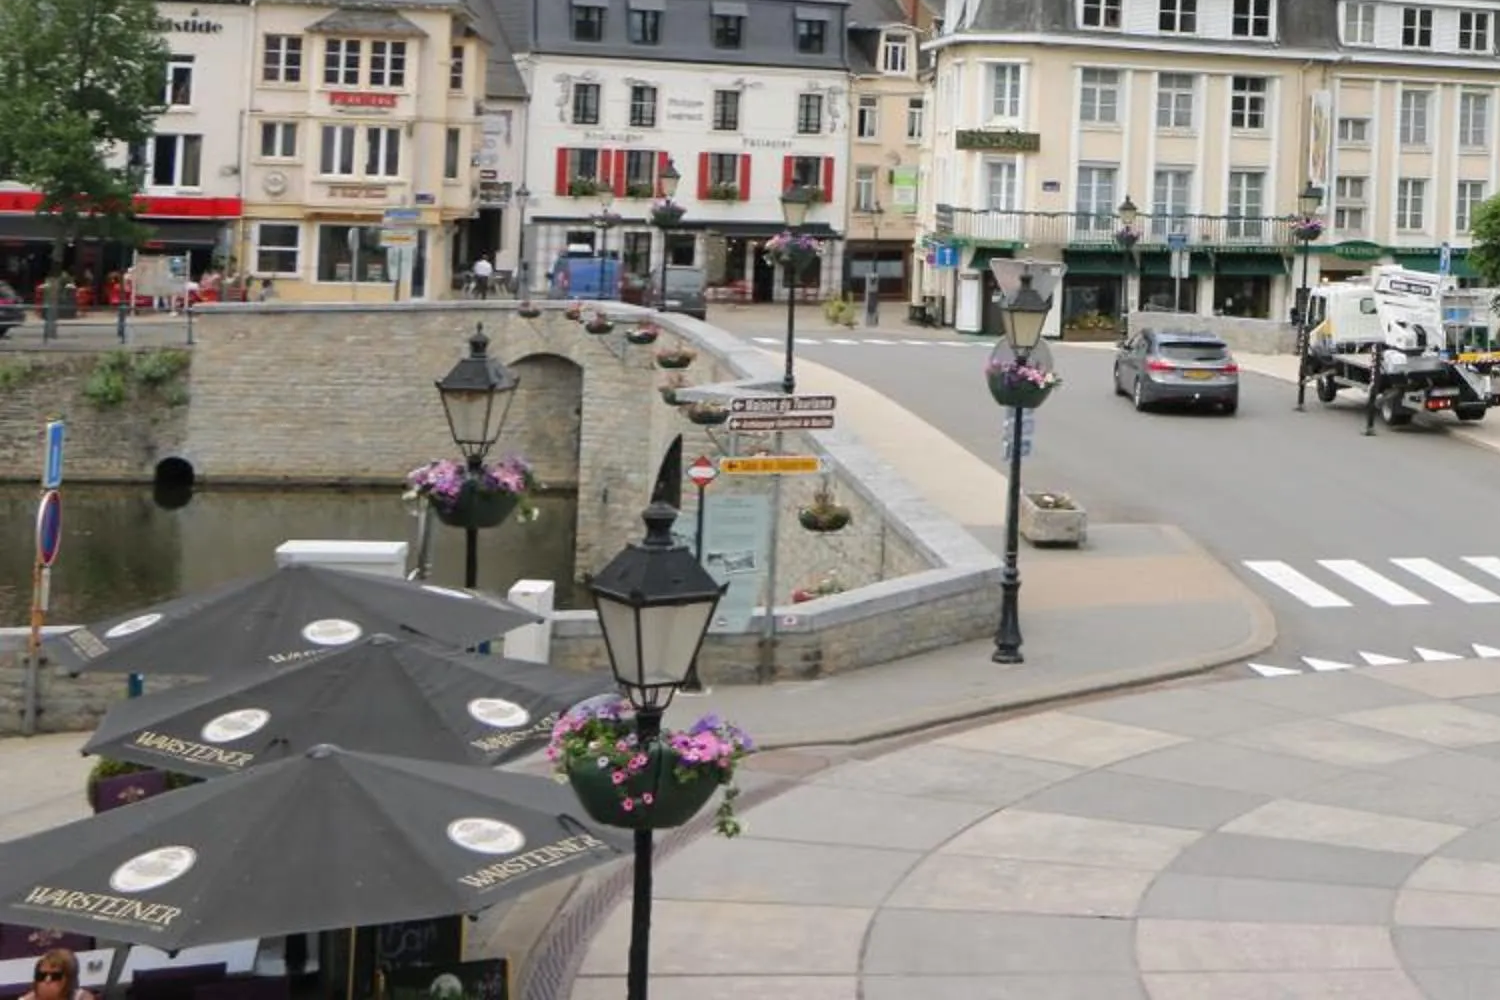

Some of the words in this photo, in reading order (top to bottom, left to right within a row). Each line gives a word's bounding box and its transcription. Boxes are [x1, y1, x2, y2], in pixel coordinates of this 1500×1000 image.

[135, 731, 256, 767] WARSTEINER
[457, 834, 603, 888] WARSTEINER
[24, 886, 183, 926] WARSTEINER
